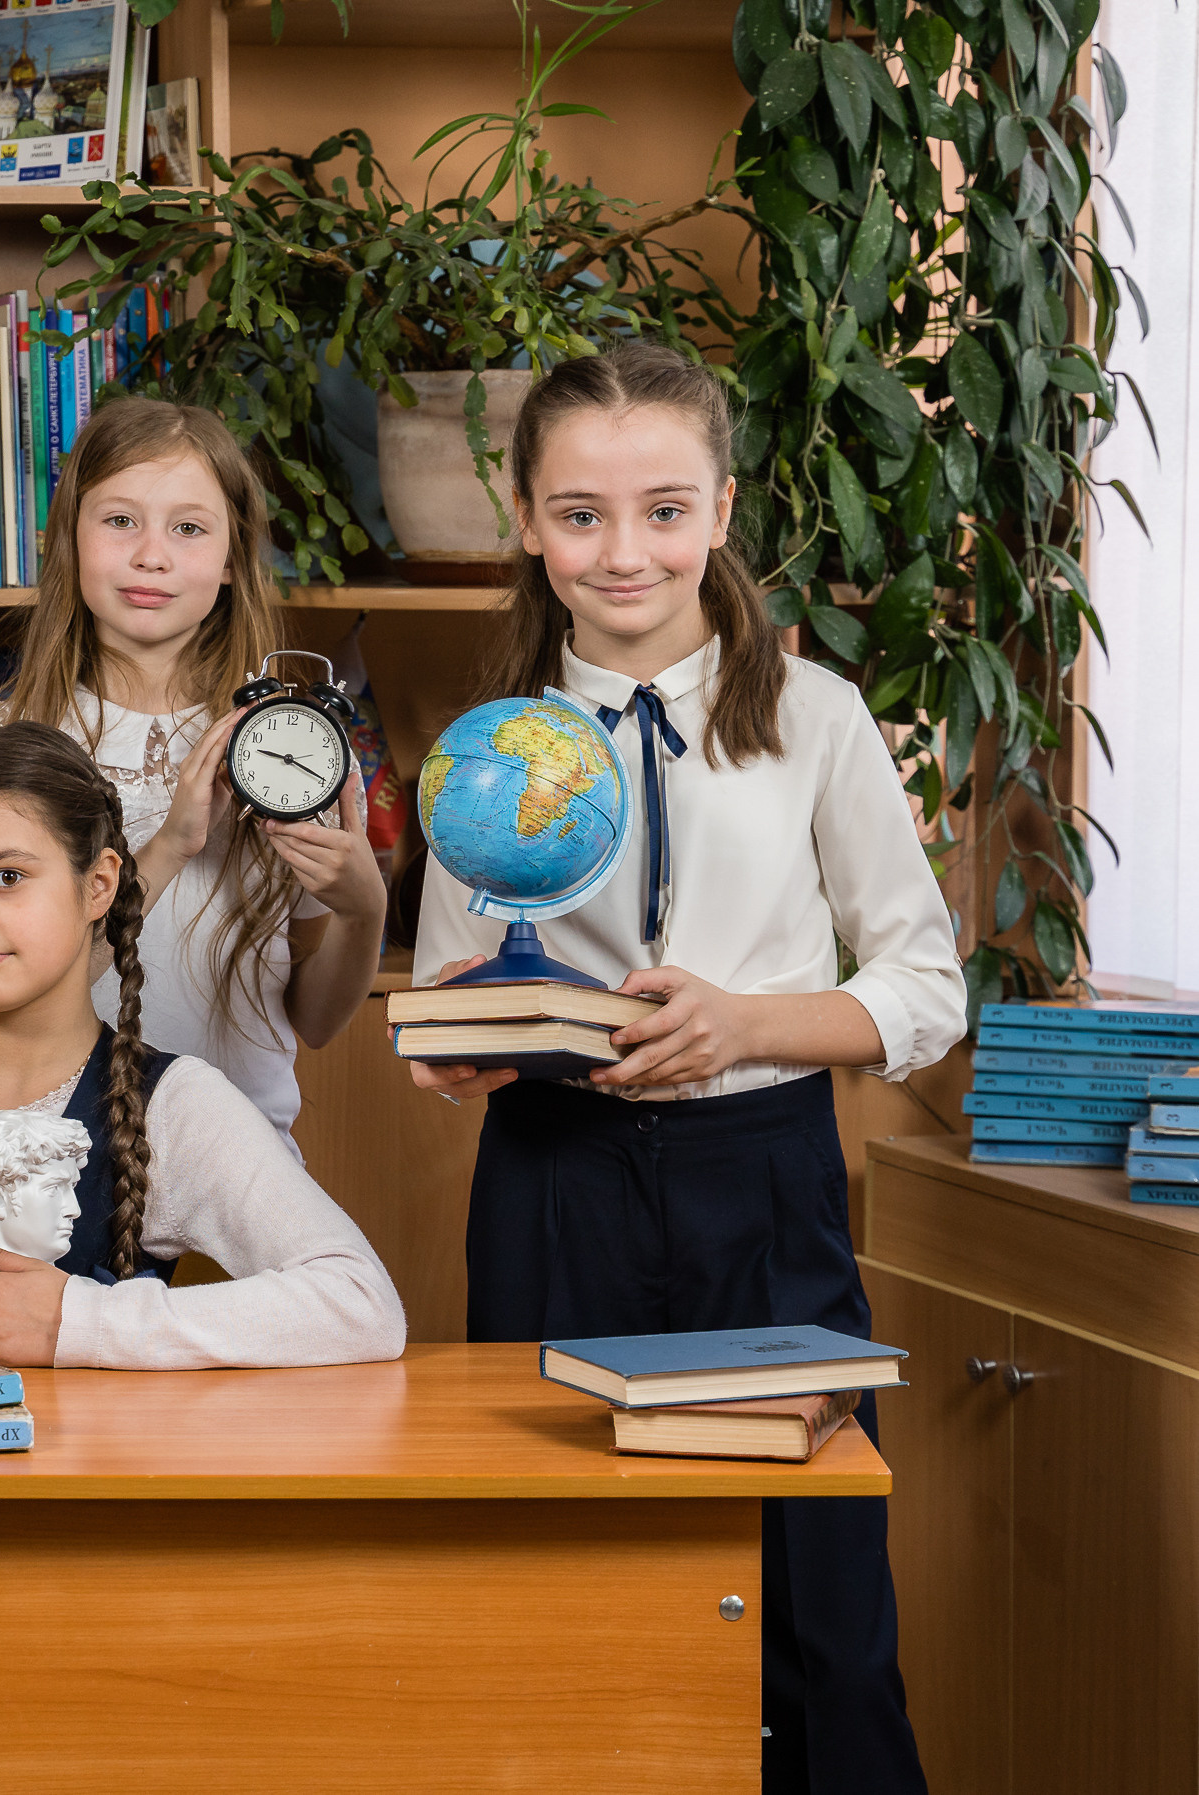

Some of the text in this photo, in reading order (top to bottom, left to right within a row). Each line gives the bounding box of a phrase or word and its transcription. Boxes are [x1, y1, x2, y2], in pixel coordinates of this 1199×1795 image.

[78, 348, 88, 417] МАТЕМАТИКА
[48, 350, 60, 434] САНКТ-ПЕТЕРБУРГЕ
[50, 435, 59, 444] О
[267, 719, 278, 730] 11
[287, 713, 299, 726] 12
[309, 721, 314, 733] 1
[252, 731, 263, 743] 10
[322, 737, 330, 748] 2
[243, 750, 250, 761] 9
[327, 758, 335, 769] 3
[247, 770, 255, 782] 8
[318, 776, 326, 788] 4
[262, 785, 270, 798] 7
[302, 790, 310, 802] 5
[280, 793, 289, 806] 6
